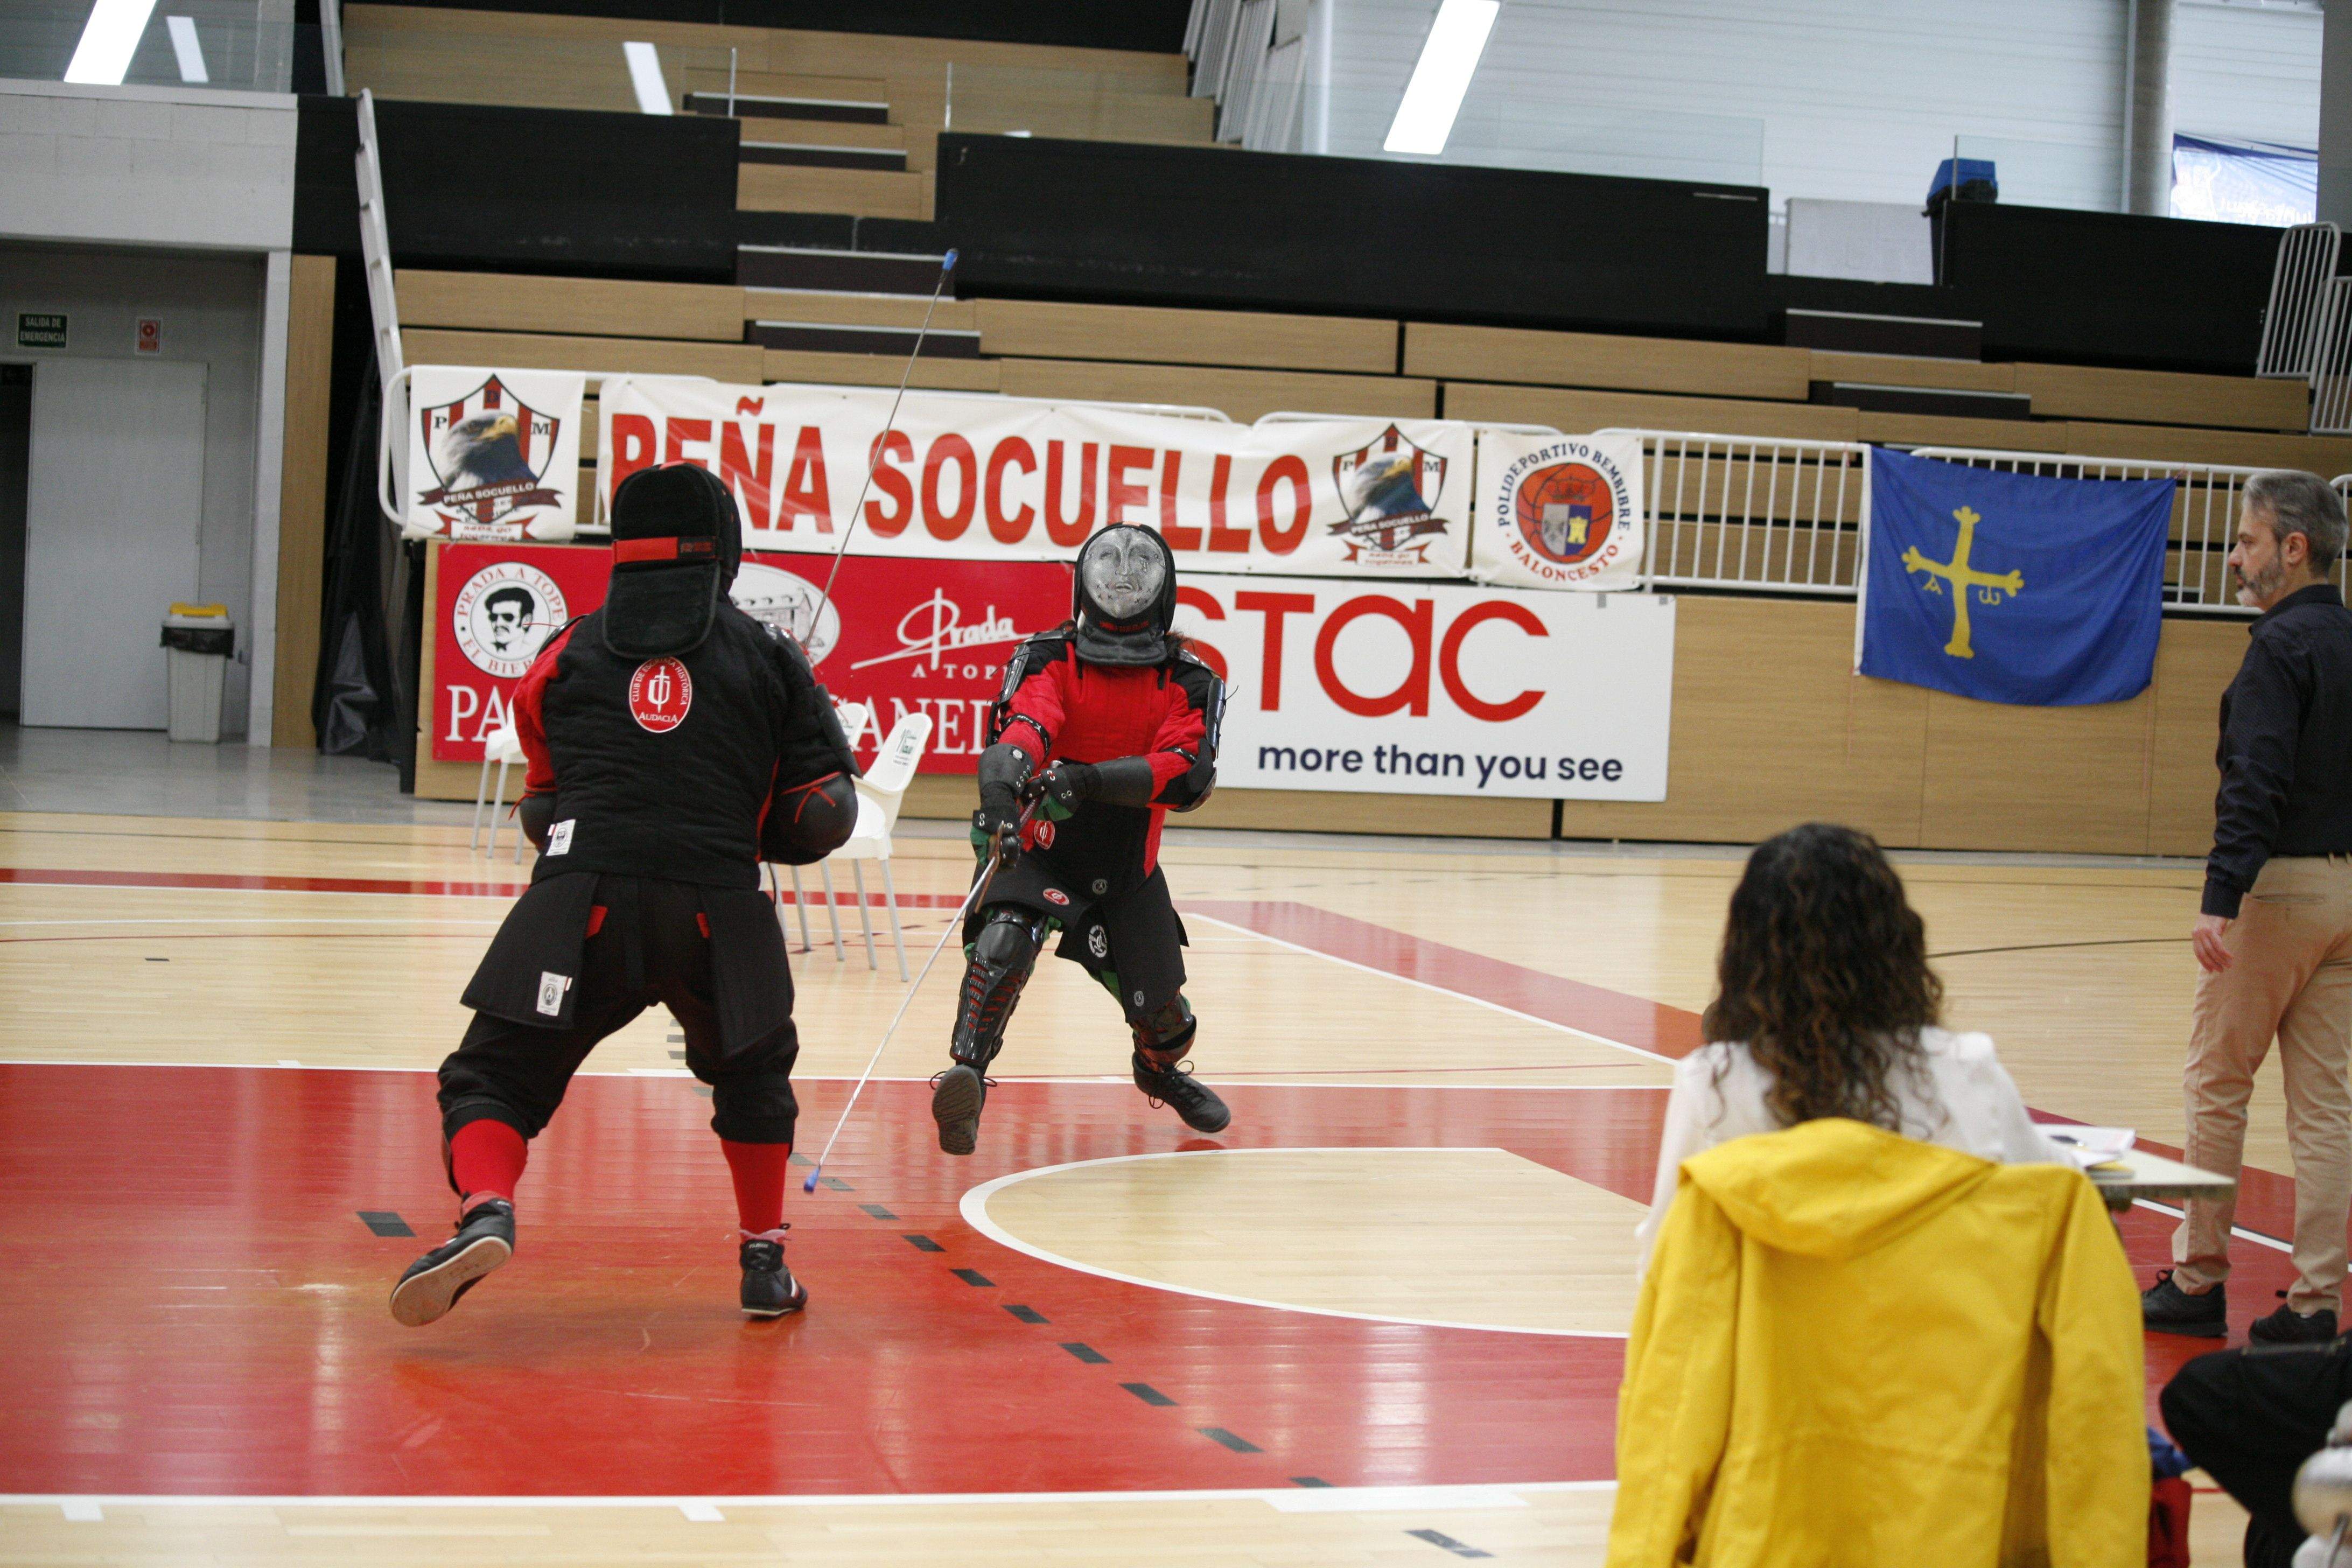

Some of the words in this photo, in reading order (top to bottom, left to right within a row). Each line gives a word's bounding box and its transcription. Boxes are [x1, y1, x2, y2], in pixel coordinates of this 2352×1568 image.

[25, 317, 50, 327] SALIDA
[52, 317, 61, 327] DE
[20, 330, 65, 343] EMERGENCIA
[433, 416, 448, 430] P
[530, 421, 551, 436] M
[1343, 461, 1354, 472] P
[1423, 461, 1439, 472] M
[611, 396, 834, 534] PEÑA
[864, 429, 1312, 556] SOCUELLO
[1497, 443, 1589, 528] POLIDEPORTIVO
[1592, 450, 1632, 531] BEMBIBRE
[1509, 540, 1619, 582] BALONCESTO
[457, 567, 506, 617] PRADA
[515, 567, 525, 579] A
[534, 572, 564, 620] TOPE
[878, 587, 1023, 670] Prada
[463, 638, 481, 663] EL
[488, 659, 535, 674] BIER
[636, 673, 645, 682] DE
[912, 663, 927, 678] A
[943, 663, 1007, 680] TOP
[632, 683, 641, 702] CLUB
[638, 711, 678, 723] AUDACIA
[1258, 746, 1363, 773] more
[1373, 744, 1464, 777] than
[1475, 755, 1546, 789] you
[1557, 757, 1623, 782] see
